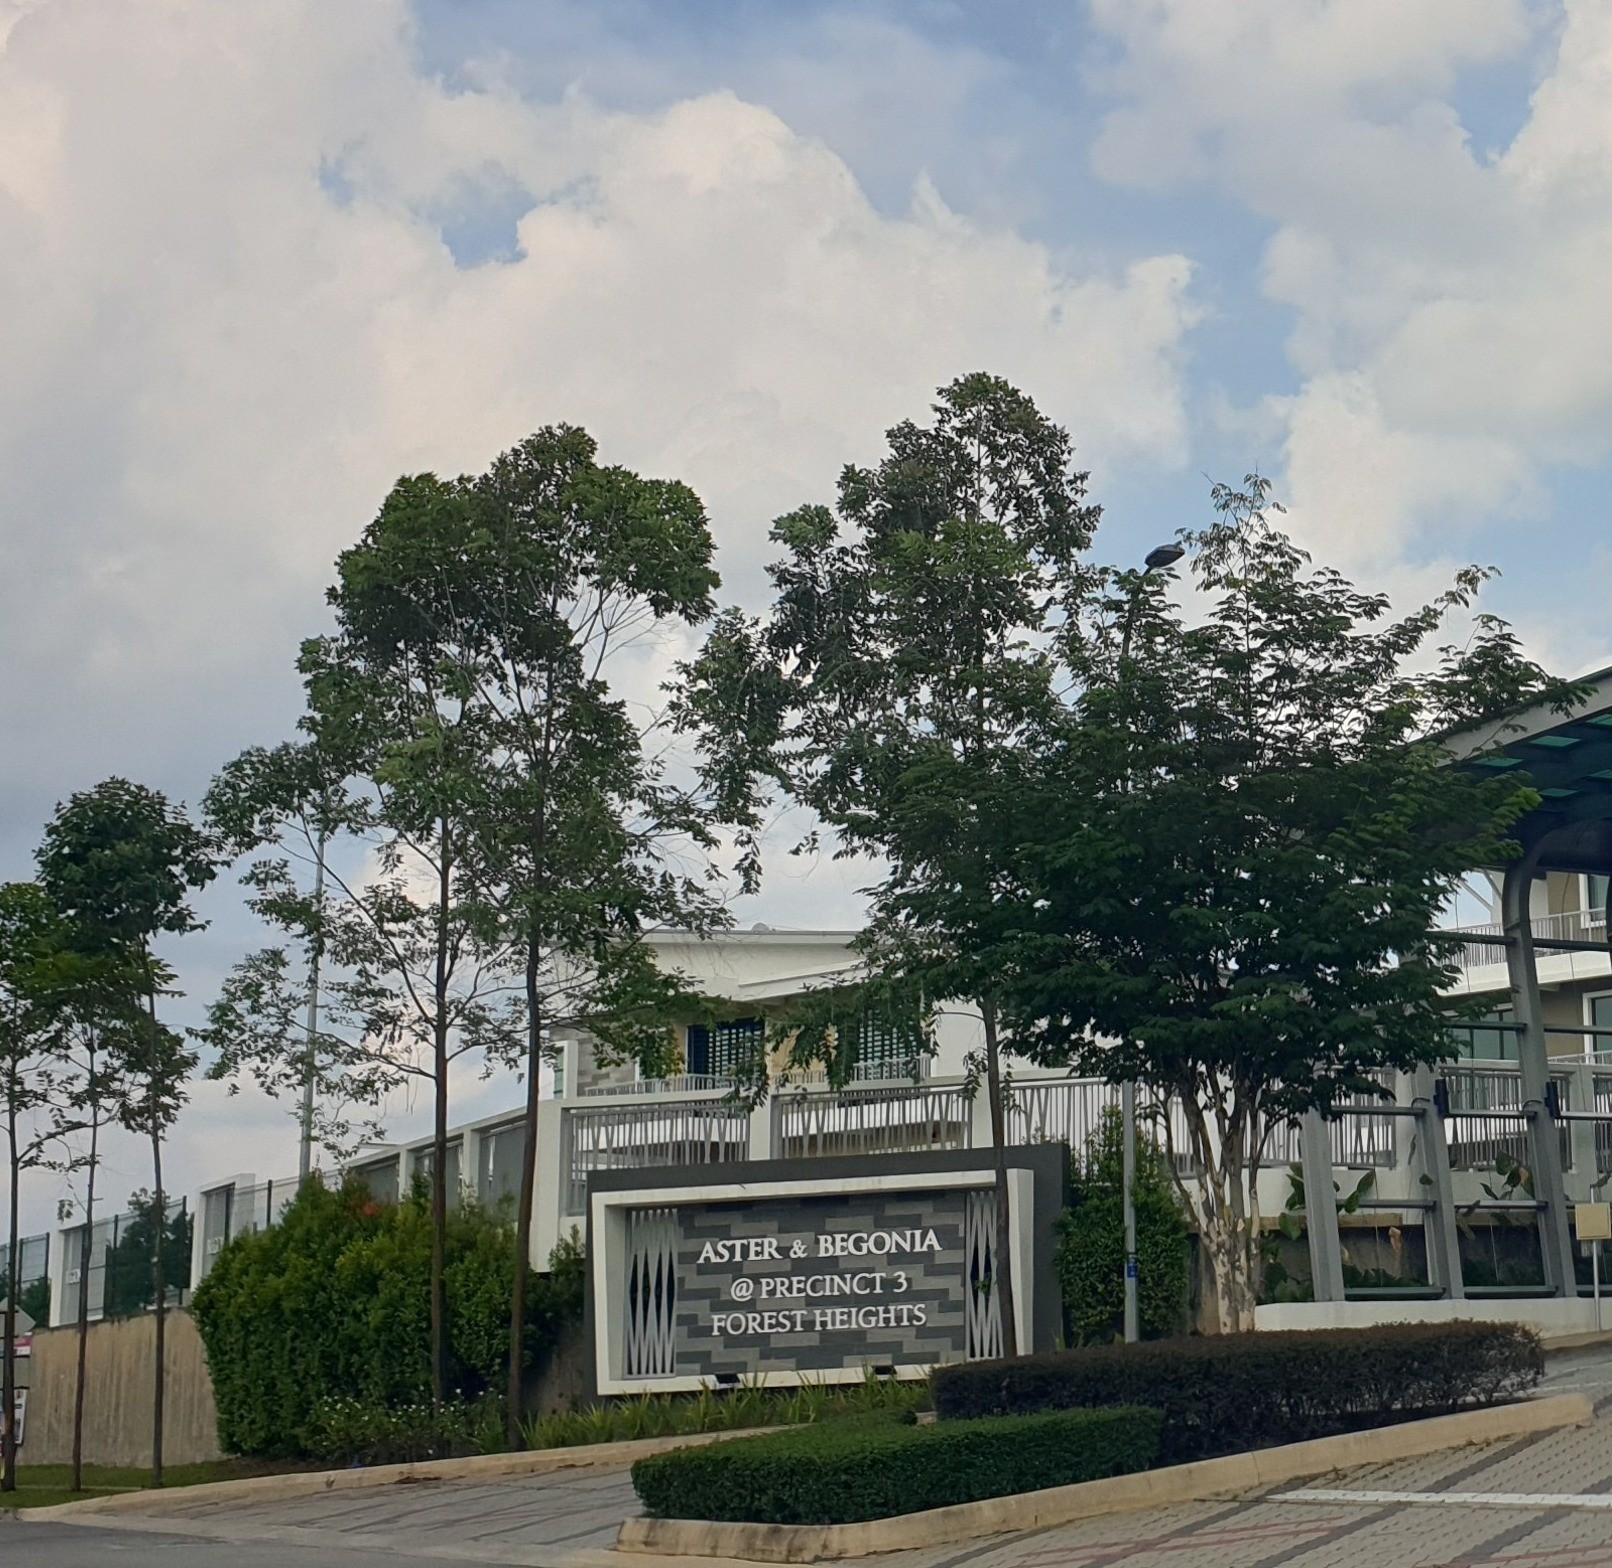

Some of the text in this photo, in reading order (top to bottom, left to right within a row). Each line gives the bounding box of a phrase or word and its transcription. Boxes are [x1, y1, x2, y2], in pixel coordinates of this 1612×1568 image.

[697, 1229, 942, 1264] ASTER & BEGONIA
[730, 1271, 908, 1302] @ PRECINCT 3
[711, 1304, 927, 1336] FOREST HEIGHTS
